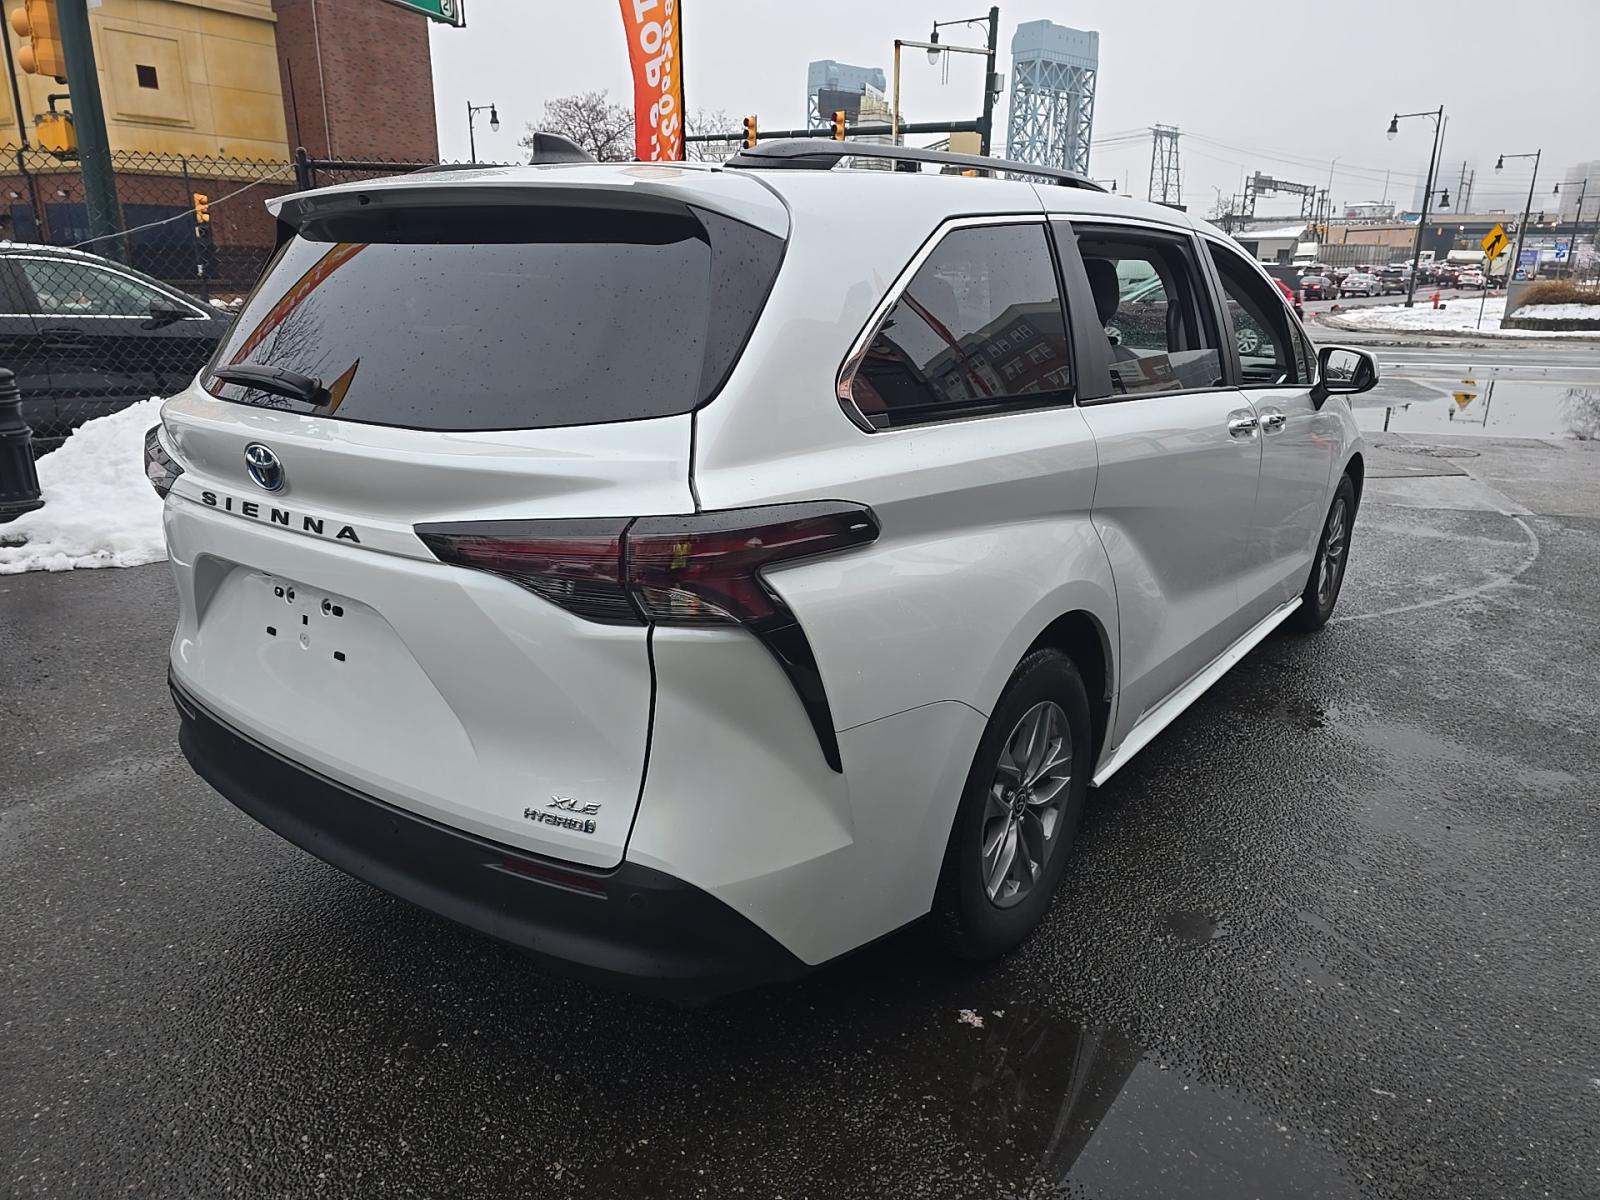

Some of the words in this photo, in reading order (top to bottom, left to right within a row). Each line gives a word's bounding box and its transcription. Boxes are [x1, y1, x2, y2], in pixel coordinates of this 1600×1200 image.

[201, 491, 361, 543] SIENNA
[545, 795, 602, 815] XLE
[524, 808, 584, 831] HYBRID
